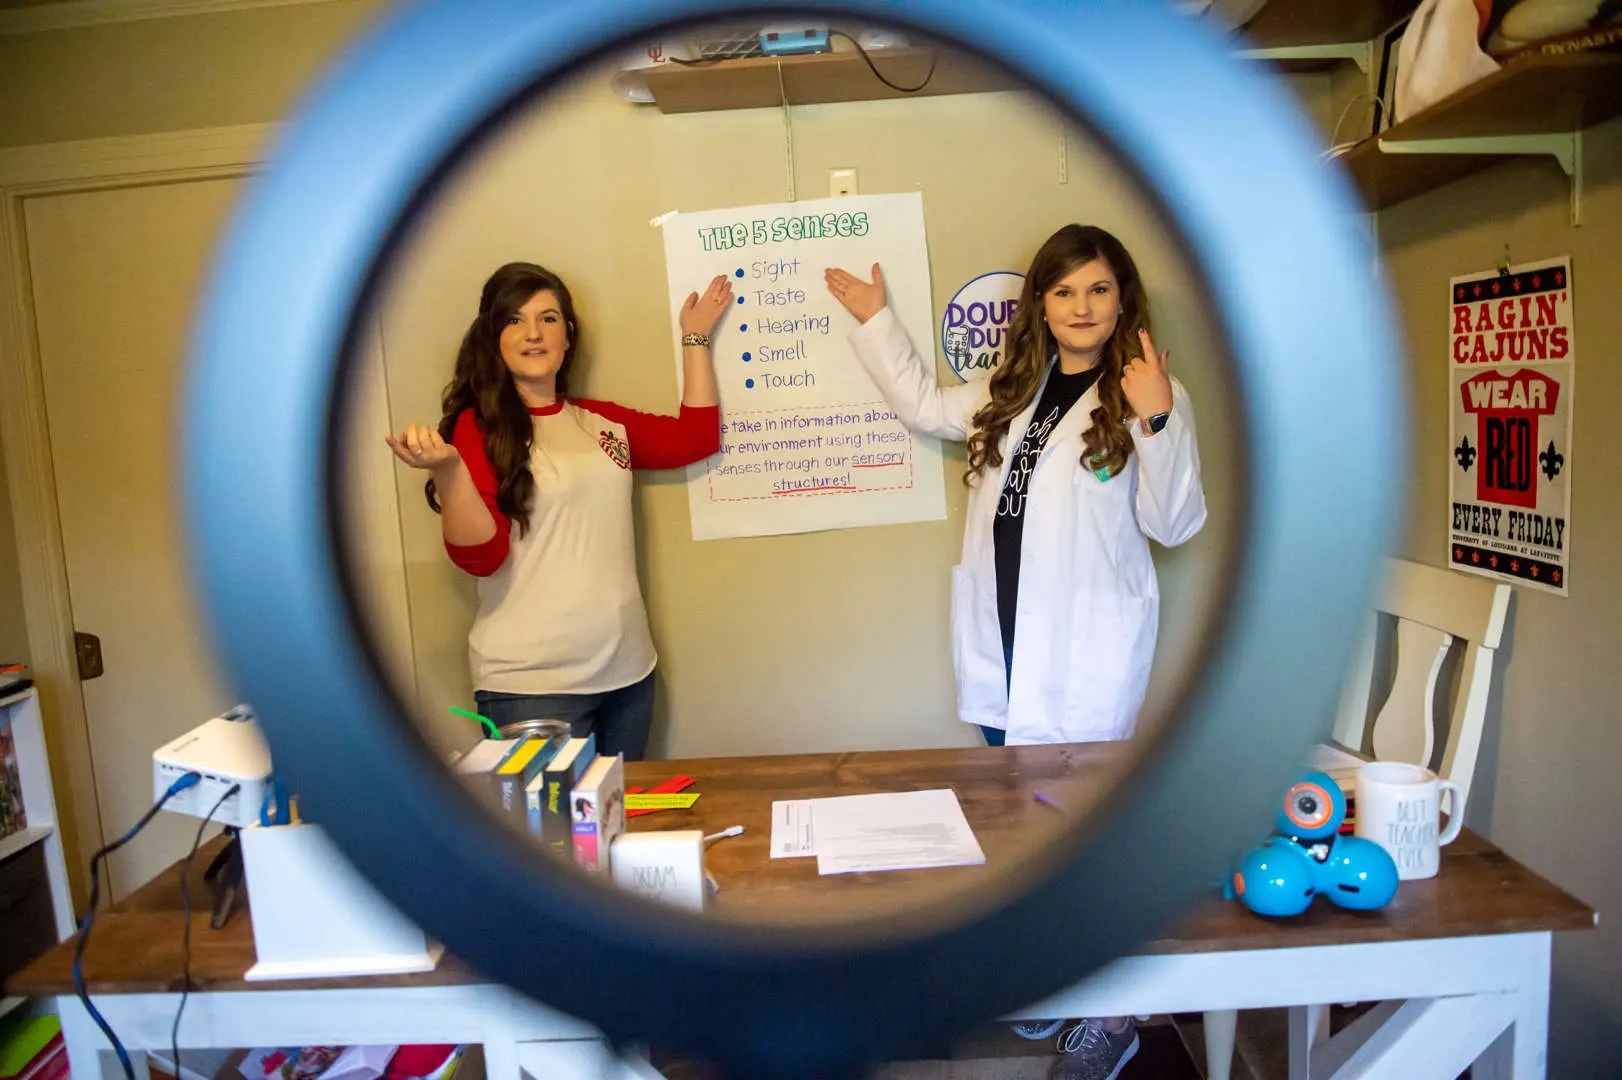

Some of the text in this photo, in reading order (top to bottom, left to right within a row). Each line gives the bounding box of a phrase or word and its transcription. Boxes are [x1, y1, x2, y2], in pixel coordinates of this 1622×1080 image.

[752, 219, 768, 245] 5
[751, 257, 801, 283] Sight
[753, 287, 806, 306] Taste
[757, 313, 830, 335] Hearing
[1453, 292, 1567, 334] RAGIN'
[759, 339, 808, 363] Smell
[1453, 326, 1569, 364] CAJUNS
[760, 369, 815, 389] Touch
[1468, 379, 1548, 409] WEAR
[720, 409, 898, 433] e take in information abou
[719, 431, 905, 454] ur environment using these
[1485, 417, 1531, 492] RED
[715, 452, 905, 475] senses through our sensory
[773, 472, 850, 490] structures!
[1452, 502, 1565, 549] EVERY FRIDAY
[1490, 541, 1518, 552] LOUISIANA
[1398, 800, 1425, 822] BEST
[632, 866, 678, 890] DREAM
